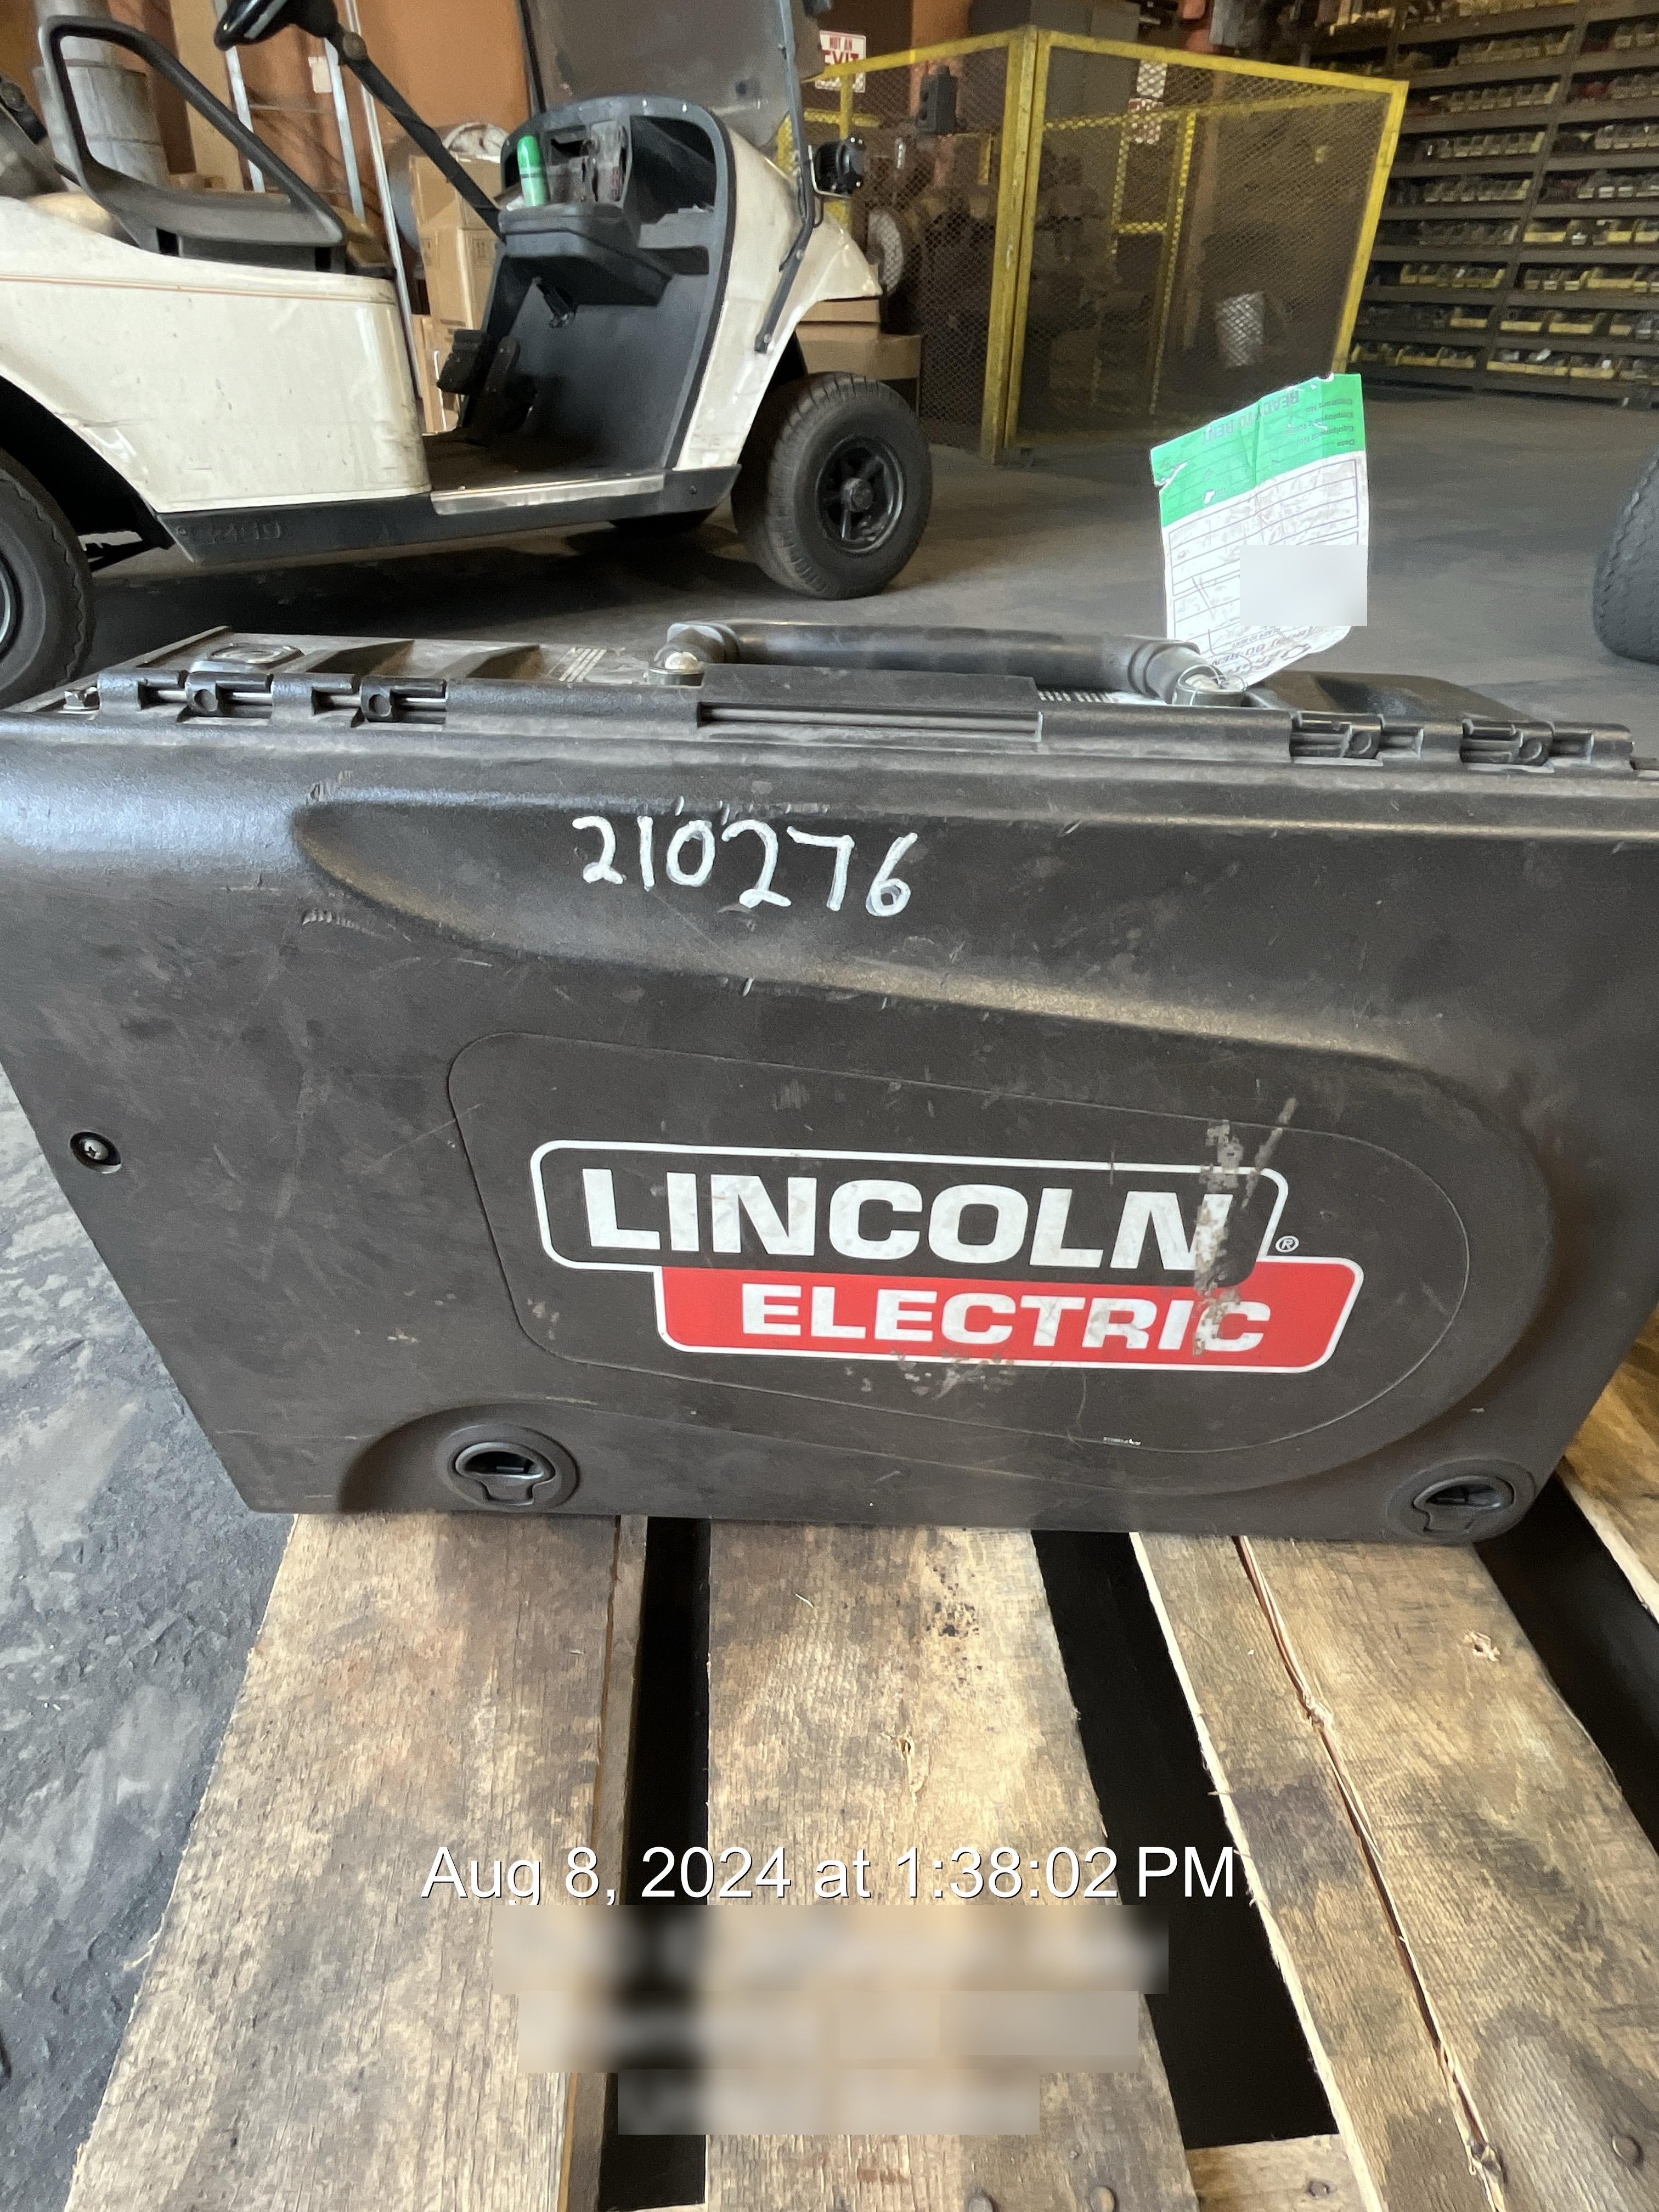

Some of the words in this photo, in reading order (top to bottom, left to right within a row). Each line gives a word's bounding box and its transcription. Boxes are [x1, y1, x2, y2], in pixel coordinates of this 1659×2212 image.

[572, 816, 918, 917] 210276
[582, 1168, 1233, 1272] LINCOLN
[742, 1283, 1271, 1352] ELECTRIC
